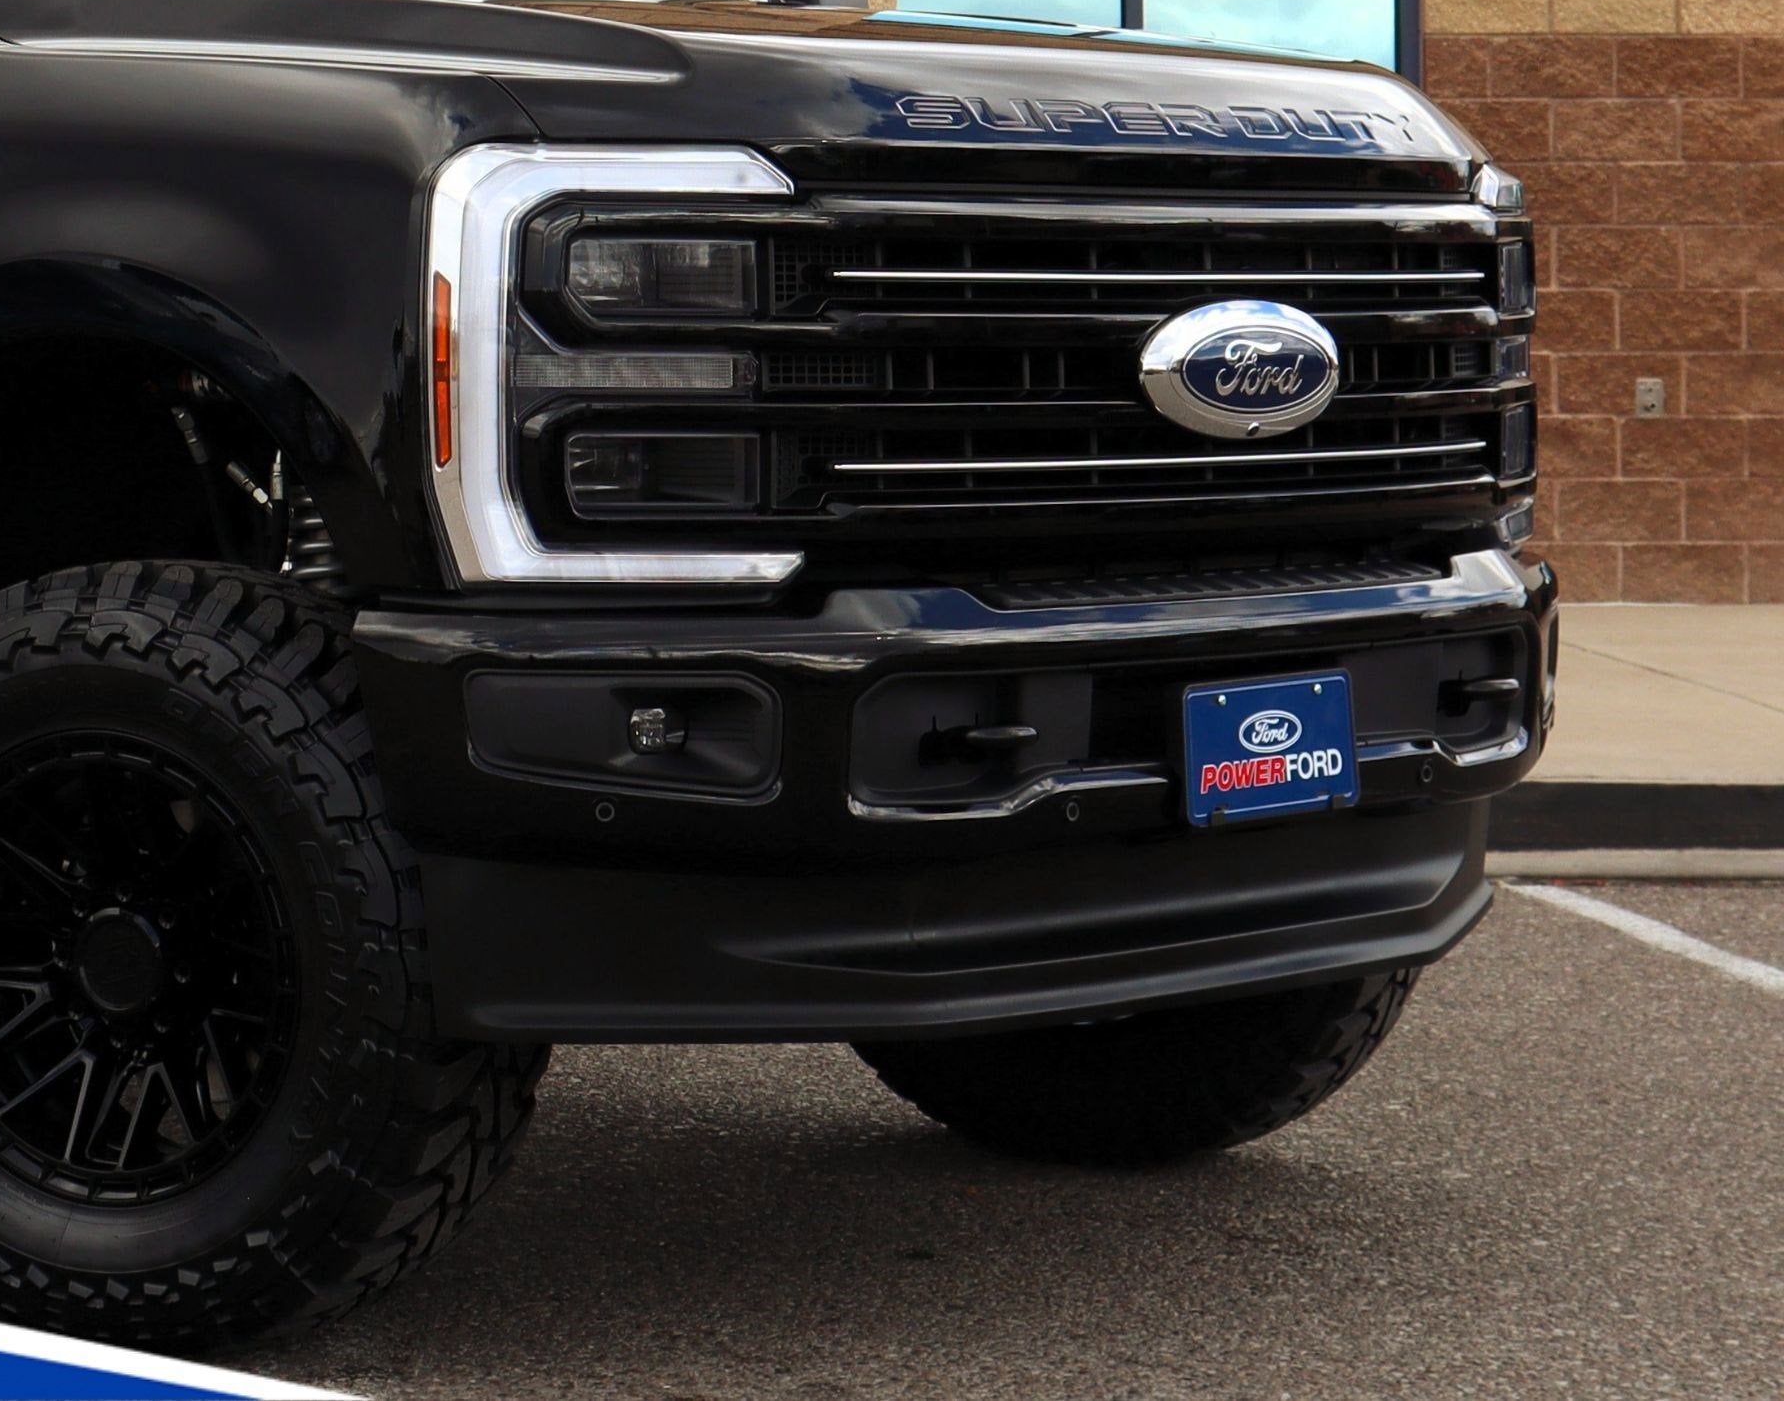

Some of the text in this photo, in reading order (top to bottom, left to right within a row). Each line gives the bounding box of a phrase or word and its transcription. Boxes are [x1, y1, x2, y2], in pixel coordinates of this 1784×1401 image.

[895, 96, 1416, 143] SUPER DUTY
[1215, 339, 1305, 396] Ford
[1251, 718, 1289, 745] Ford
